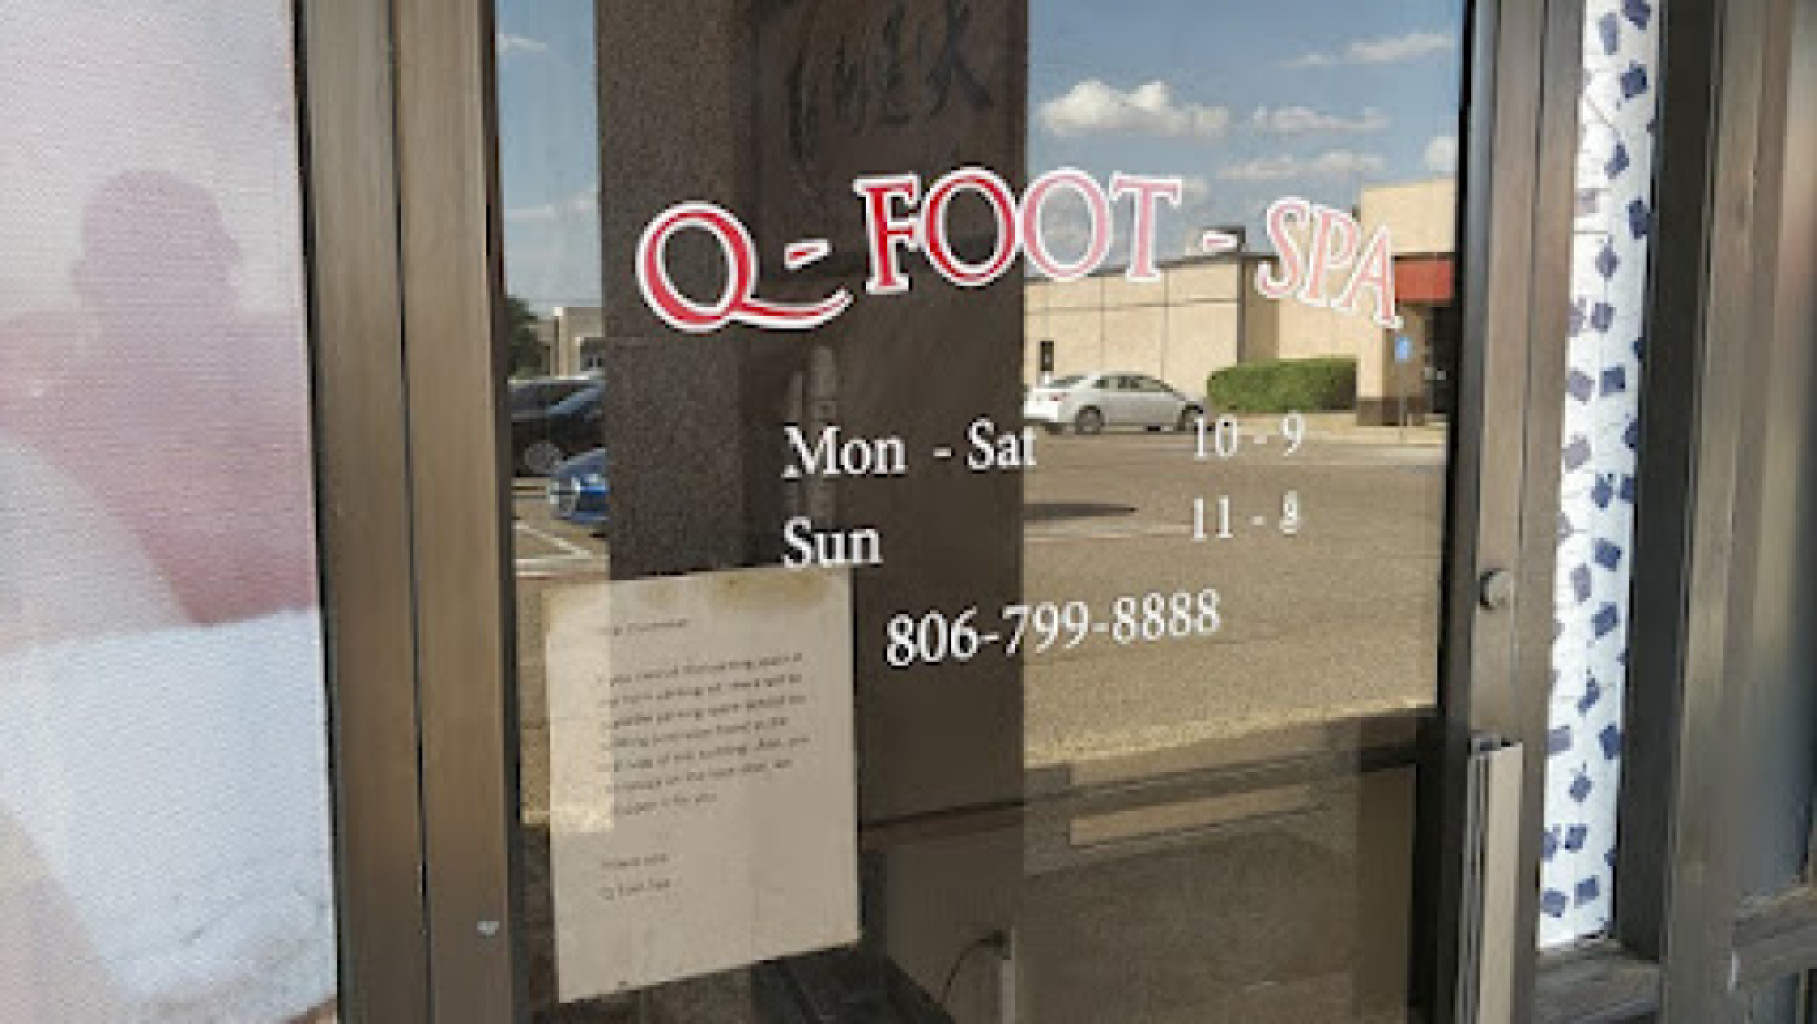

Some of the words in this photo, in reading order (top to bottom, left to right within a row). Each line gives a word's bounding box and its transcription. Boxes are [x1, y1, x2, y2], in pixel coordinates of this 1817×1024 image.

[635, 201, 855, 332] Q
[853, 167, 1181, 295] FOOT
[1255, 197, 1403, 329] SPA
[781, 425, 907, 477] Mon
[967, 418, 1036, 469] Sat
[1194, 412, 1237, 460] 10
[1283, 410, 1306, 456] 9
[783, 516, 883, 568] Sun
[1192, 495, 1233, 541] 11
[886, 588, 1220, 667] 806-799-8888
